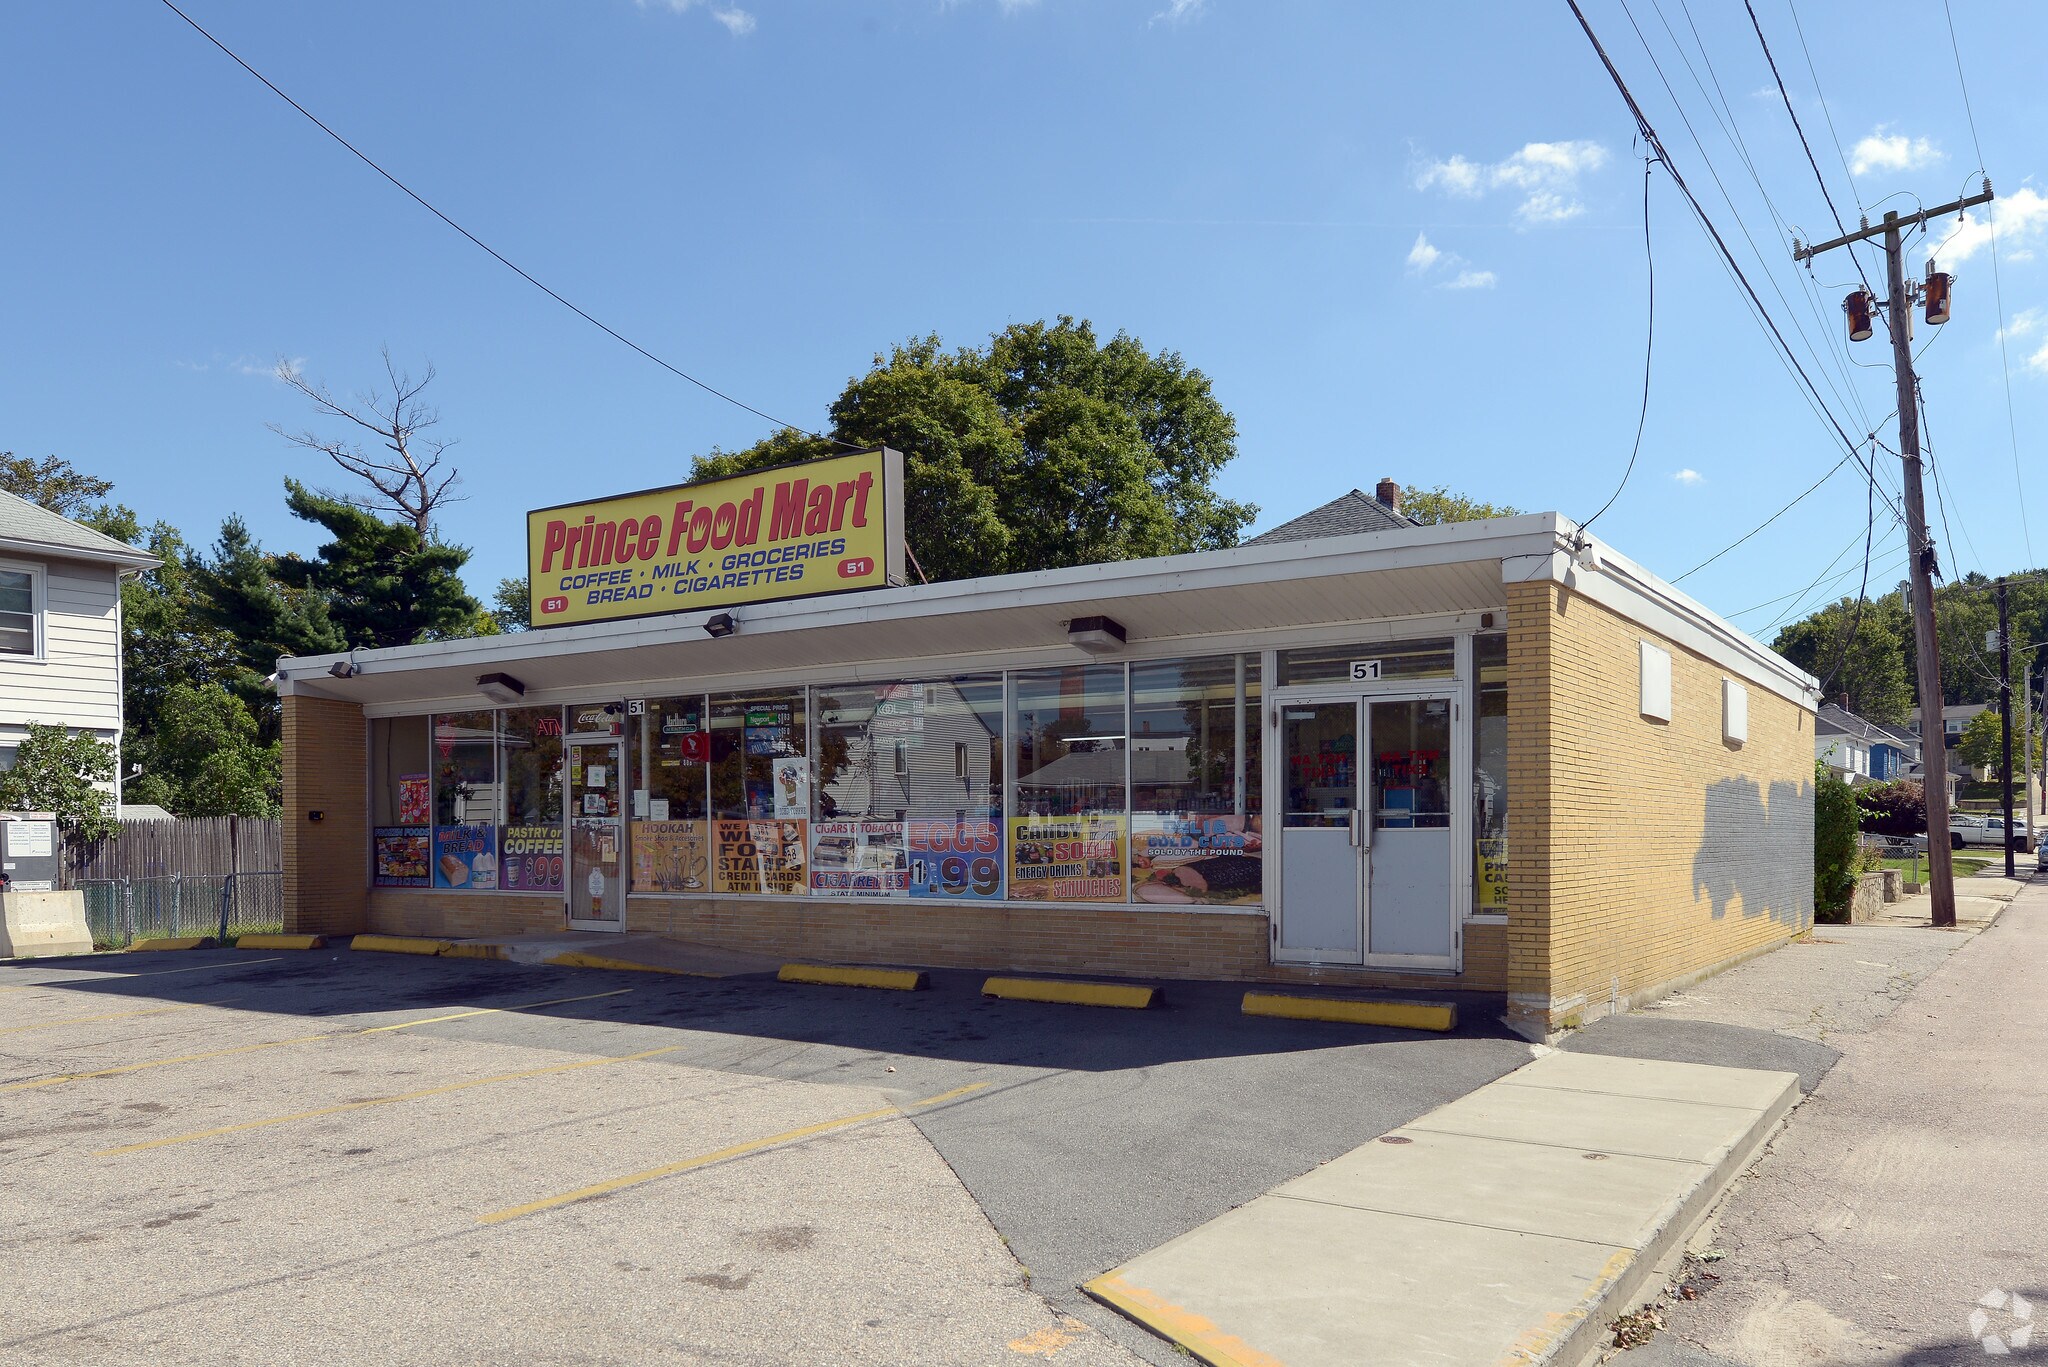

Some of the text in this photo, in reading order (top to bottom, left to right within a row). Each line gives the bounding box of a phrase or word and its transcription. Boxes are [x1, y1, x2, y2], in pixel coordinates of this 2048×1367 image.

[541, 471, 873, 573] Prince Food Mart
[560, 538, 846, 591] COFFEE MILK GROCERIES
[846, 561, 865, 574] 51
[586, 564, 804, 605] BREAD CIGARETTES
[547, 599, 562, 610] 51
[1353, 663, 1379, 679] 51
[630, 702, 644, 713] 51
[537, 718, 563, 735] ATM
[750, 716, 769, 724] Newport
[404, 827, 430, 837] FOODS
[438, 828, 488, 843] MILK &
[507, 827, 563, 838] PASTRY or
[642, 824, 694, 833] HOOKAH
[815, 823, 904, 834] CIGARS & TOBACCO
[1016, 823, 1082, 841] CANDY
[909, 822, 999, 854] EGGS
[1148, 836, 1246, 848] COLD CUTS
[442, 840, 485, 854] BREAD
[504, 838, 564, 855] COFFEE
[1055, 840, 1118, 861] SODA
[718, 872, 802, 882] CREDIT CARDS
[1015, 864, 1083, 879] ENERGY DRINKS
[727, 882, 750, 892] ATM
[1053, 879, 1121, 898] SANWICHES
